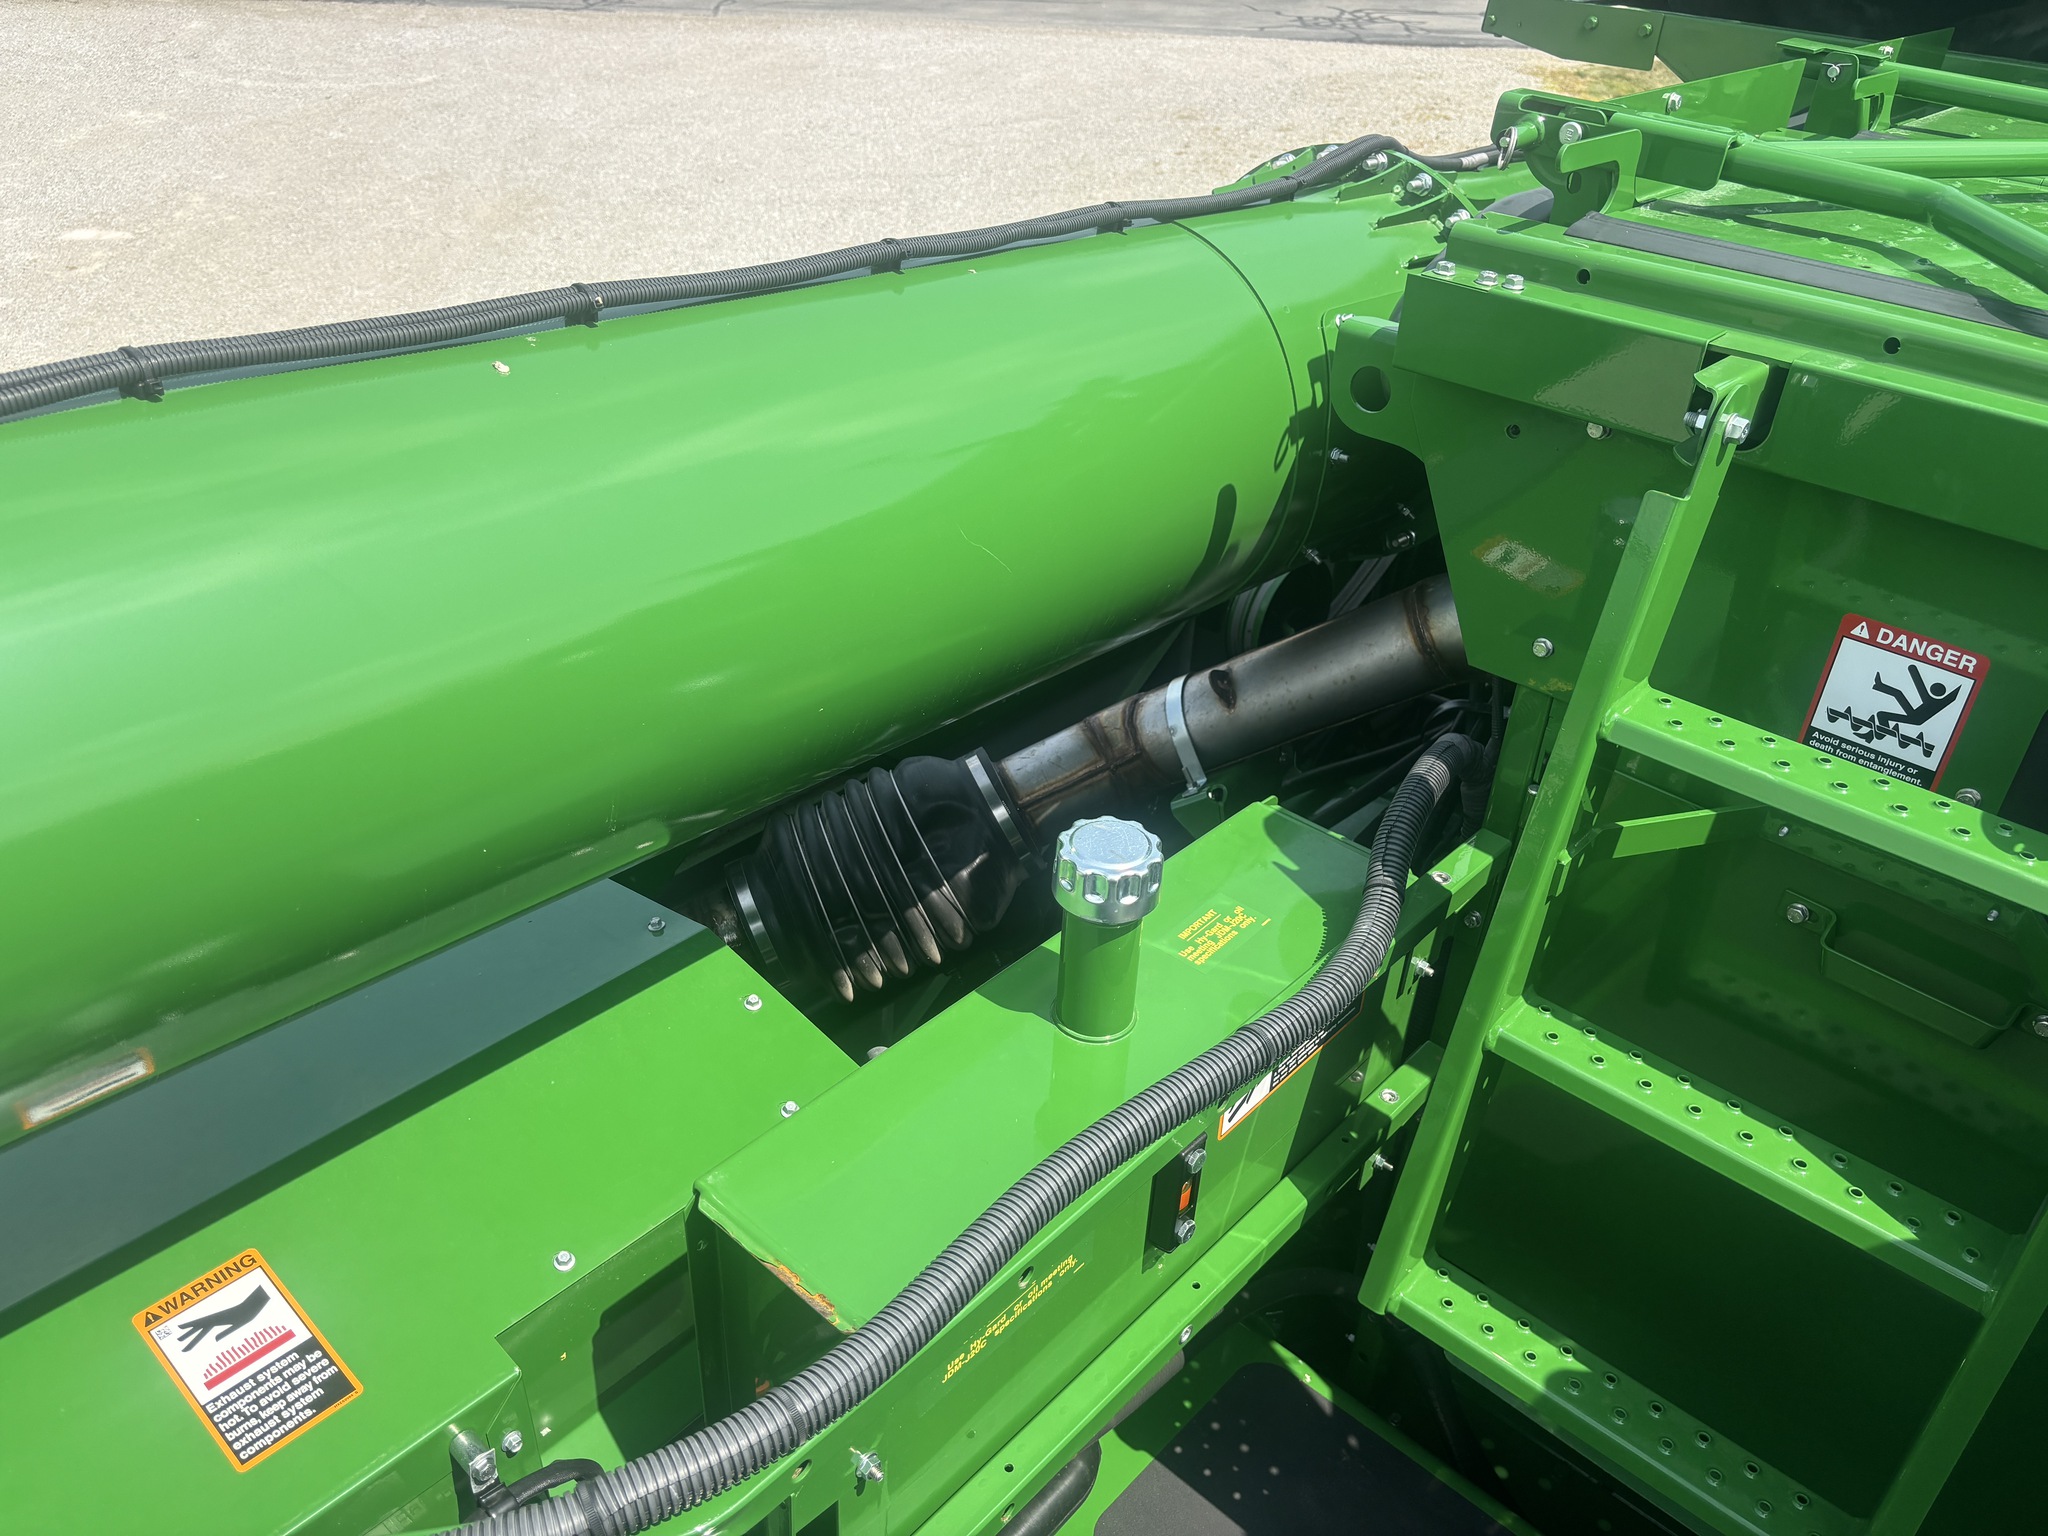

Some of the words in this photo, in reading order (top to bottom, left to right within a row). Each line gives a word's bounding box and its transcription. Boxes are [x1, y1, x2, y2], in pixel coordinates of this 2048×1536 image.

[1876, 627, 1978, 673] DANGER
[1809, 739, 1833, 753] death
[1835, 748, 1857, 761] from
[1858, 758, 1922, 786] entanglement.
[1812, 731, 1839, 745] Avoid
[1841, 743, 1876, 760] serious
[1877, 755, 1906, 771] injury
[1907, 766, 1919, 775] or
[1177, 909, 1217, 940] IMPORTANT
[1178, 946, 1195, 957] Use
[1194, 922, 1223, 944] Hy-Gard
[1223, 915, 1233, 923] or
[1234, 905, 1245, 914] oil
[1187, 940, 1216, 961] meeting
[1215, 913, 1247, 938] JDM-J20C
[1194, 930, 1239, 965] specifications
[1240, 916, 1257, 929] only.
[158, 1254, 258, 1315] WARNING
[947, 1353, 965, 1370] Use
[970, 1314, 1007, 1351] Hy-Gard
[1013, 1300, 1023, 1311] or
[1028, 1285, 1038, 1299] oil
[1040, 1254, 1073, 1287] meeting
[942, 1340, 987, 1383] JDM-J20C
[994, 1281, 1053, 1337] specifications
[1059, 1258, 1078, 1277] only.
[205, 1378, 257, 1414] Exhaust
[256, 1352, 300, 1382] system
[213, 1376, 283, 1423] components
[282, 1359, 307, 1379] may
[305, 1350, 323, 1363] be
[218, 1414, 244, 1432] hot.
[241, 1404, 258, 1417] To
[259, 1381, 291, 1407] avoid
[291, 1358, 330, 1386] severe
[225, 1416, 262, 1442] burns,
[259, 1399, 287, 1419] keep
[286, 1381, 314, 1402] away
[312, 1365, 339, 1384] from
[232, 1415, 281, 1450] exhaust
[281, 1388, 324, 1419] system
[239, 1408, 317, 1460] components.
